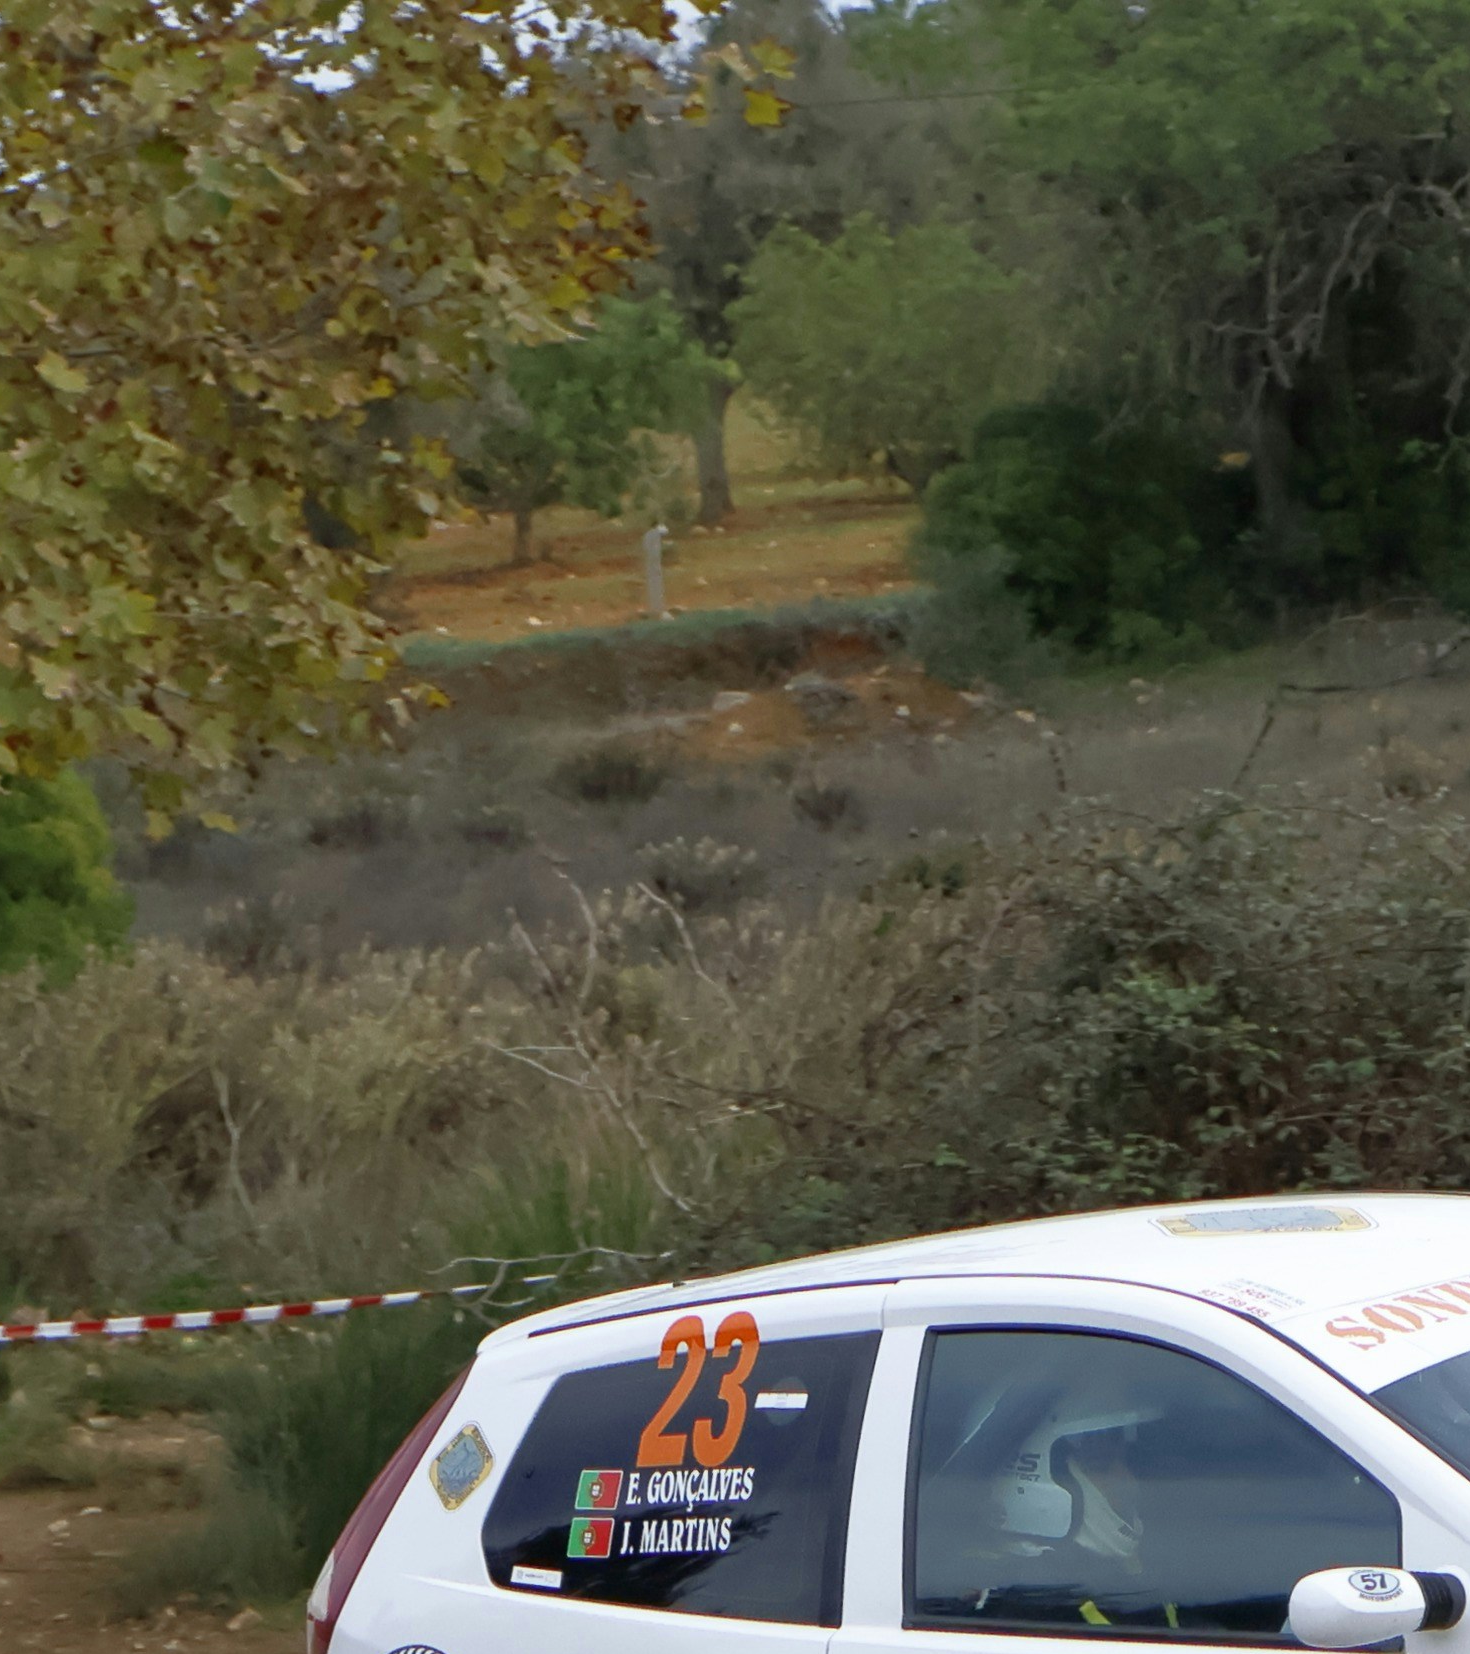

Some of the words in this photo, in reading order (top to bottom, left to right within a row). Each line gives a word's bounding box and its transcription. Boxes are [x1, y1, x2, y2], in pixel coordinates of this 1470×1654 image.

[636, 1311, 760, 1467] 23
[625, 1472, 641, 1505] E.
[646, 1467, 756, 1511] GONÇALVES
[620, 1520, 634, 1555] J.
[639, 1517, 732, 1554] MARTINS
[1360, 1572, 1388, 1591] 57
